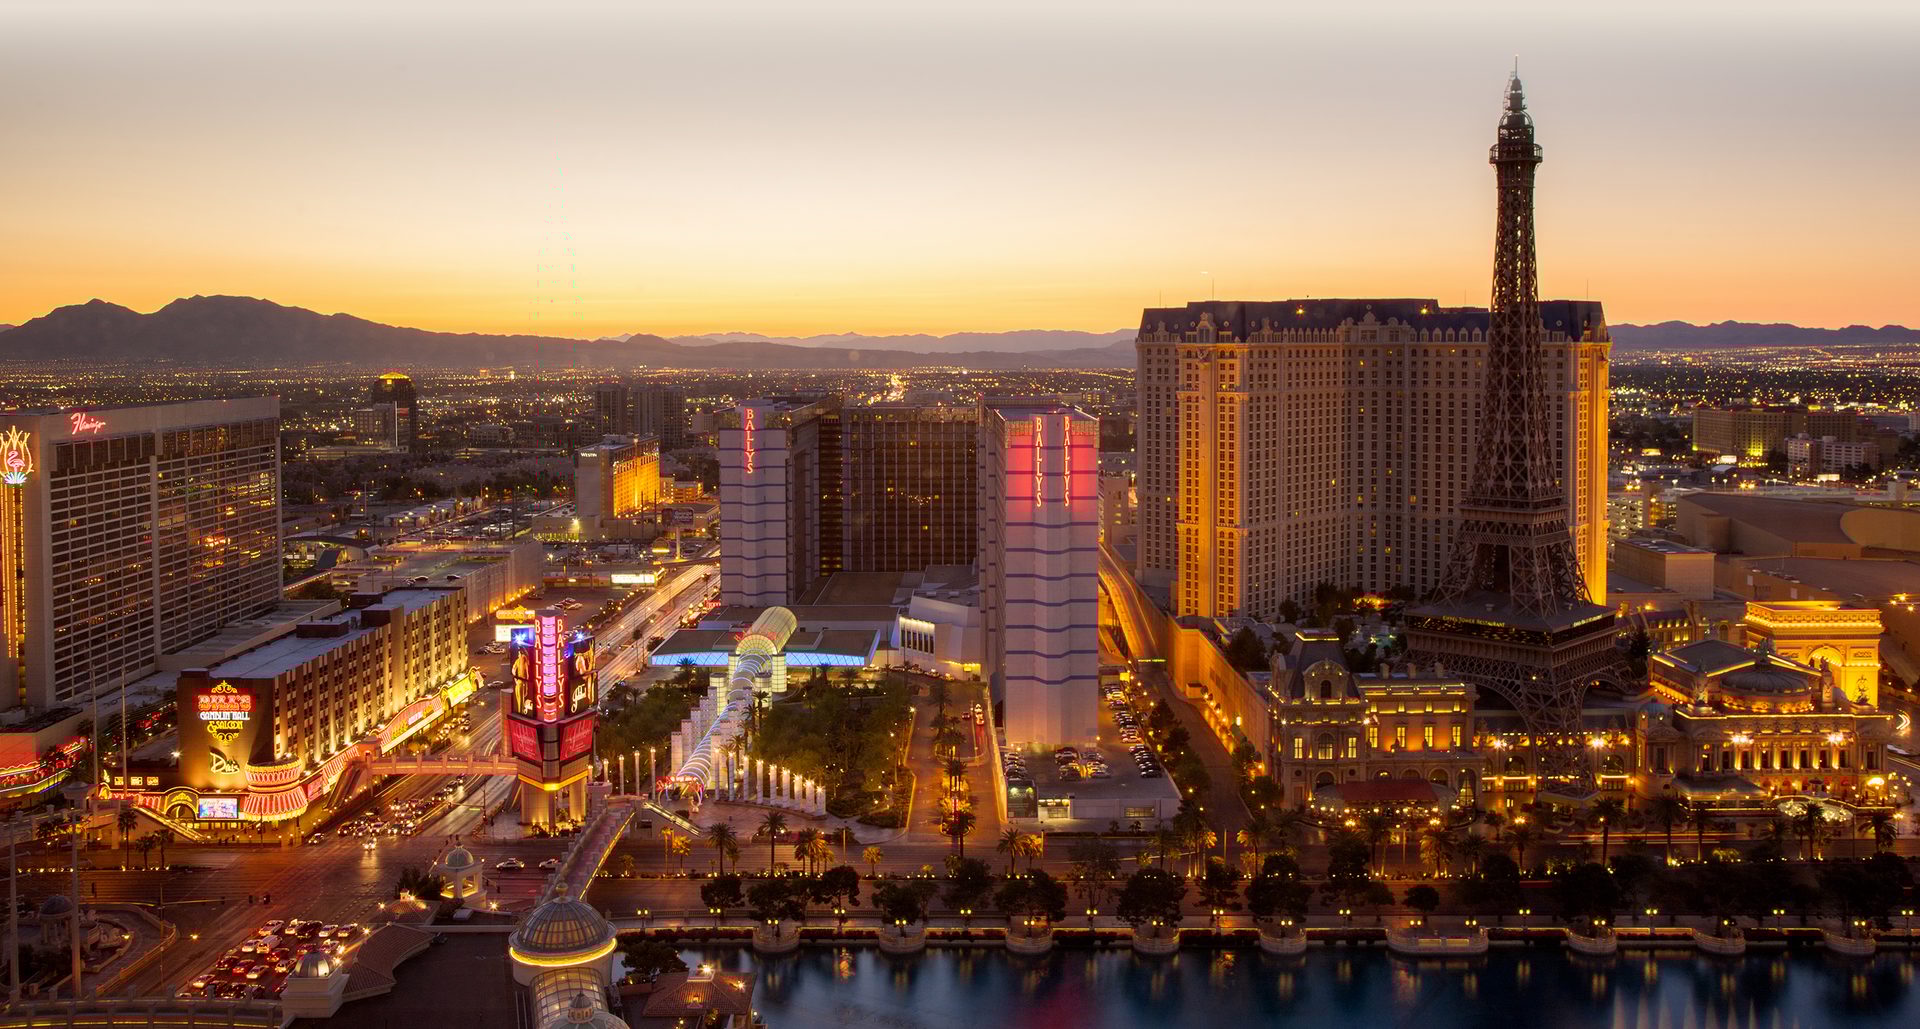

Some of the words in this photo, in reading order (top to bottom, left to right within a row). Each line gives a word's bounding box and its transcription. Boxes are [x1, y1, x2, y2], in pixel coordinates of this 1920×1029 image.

[745, 408, 755, 474] BALLYS
[1035, 417, 1043, 507] BALLYS
[534, 619, 542, 709] BALLYS
[557, 619, 565, 708] BALLYS
[216, 721, 243, 729] SALOON
